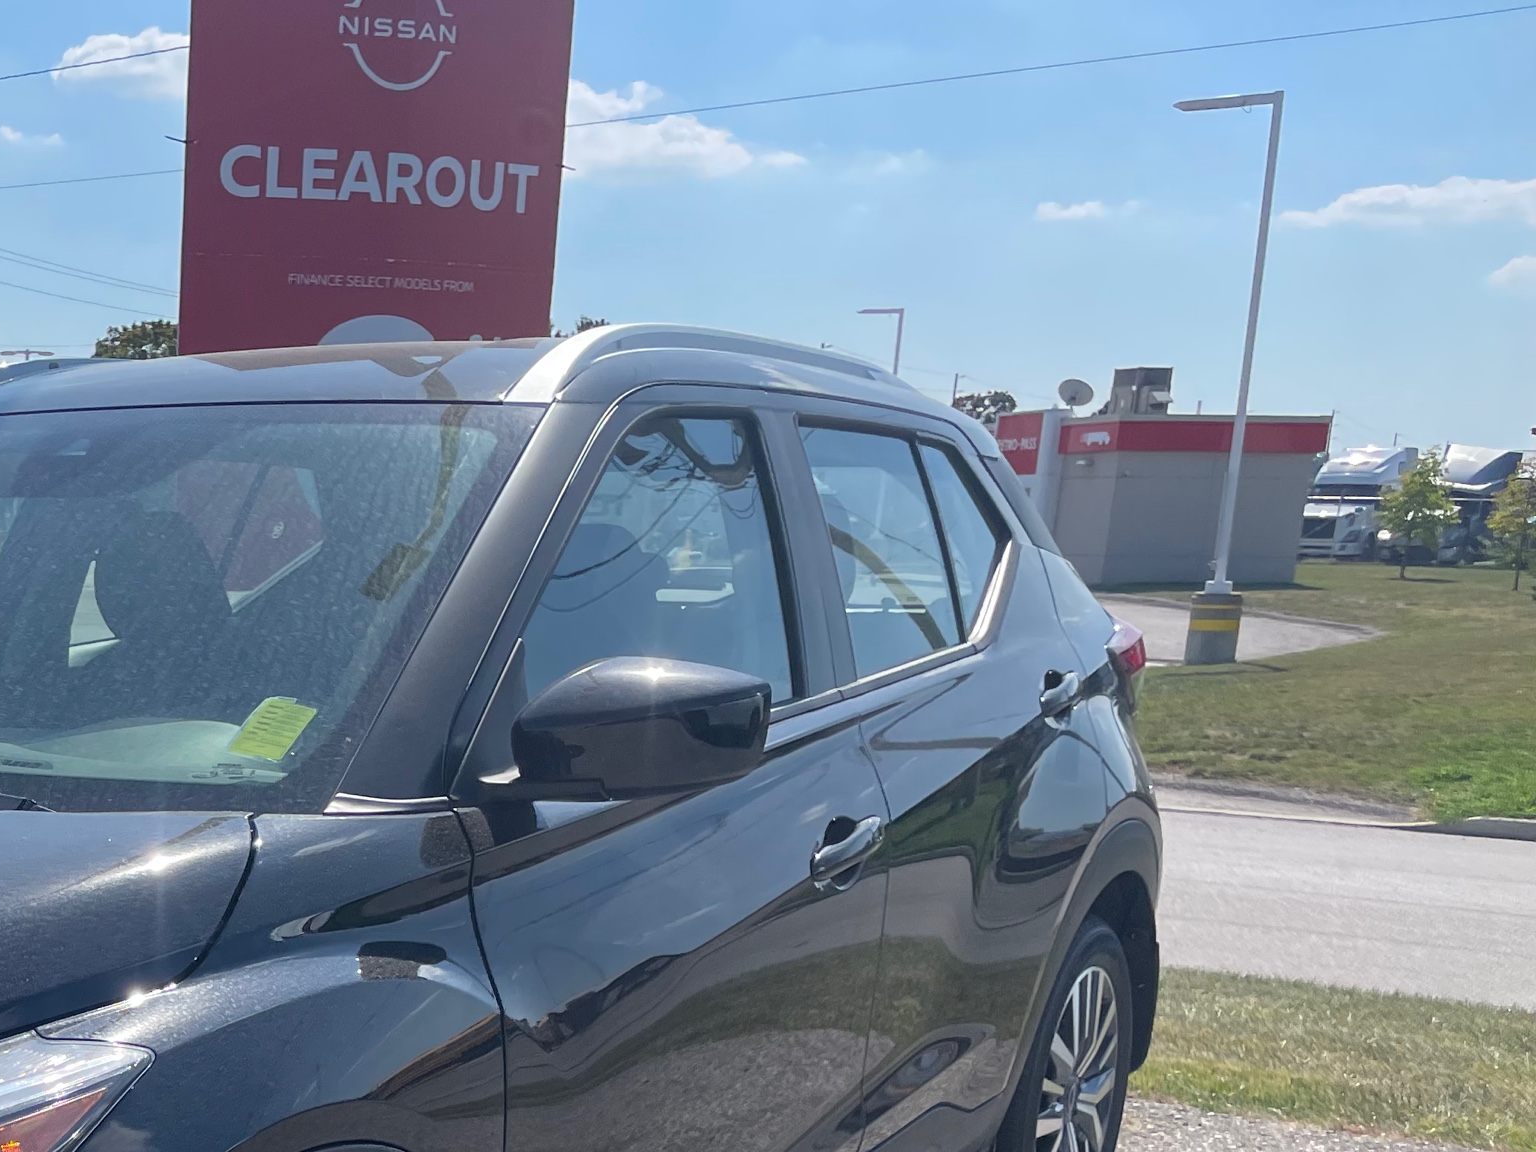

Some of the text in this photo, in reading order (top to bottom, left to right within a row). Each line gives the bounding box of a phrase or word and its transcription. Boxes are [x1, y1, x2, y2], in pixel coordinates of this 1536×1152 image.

[339, 16, 457, 44] NISSAN
[220, 144, 539, 214] CLEAROUT
[288, 273, 475, 293] FINANCE SELECT MODELS FROM
